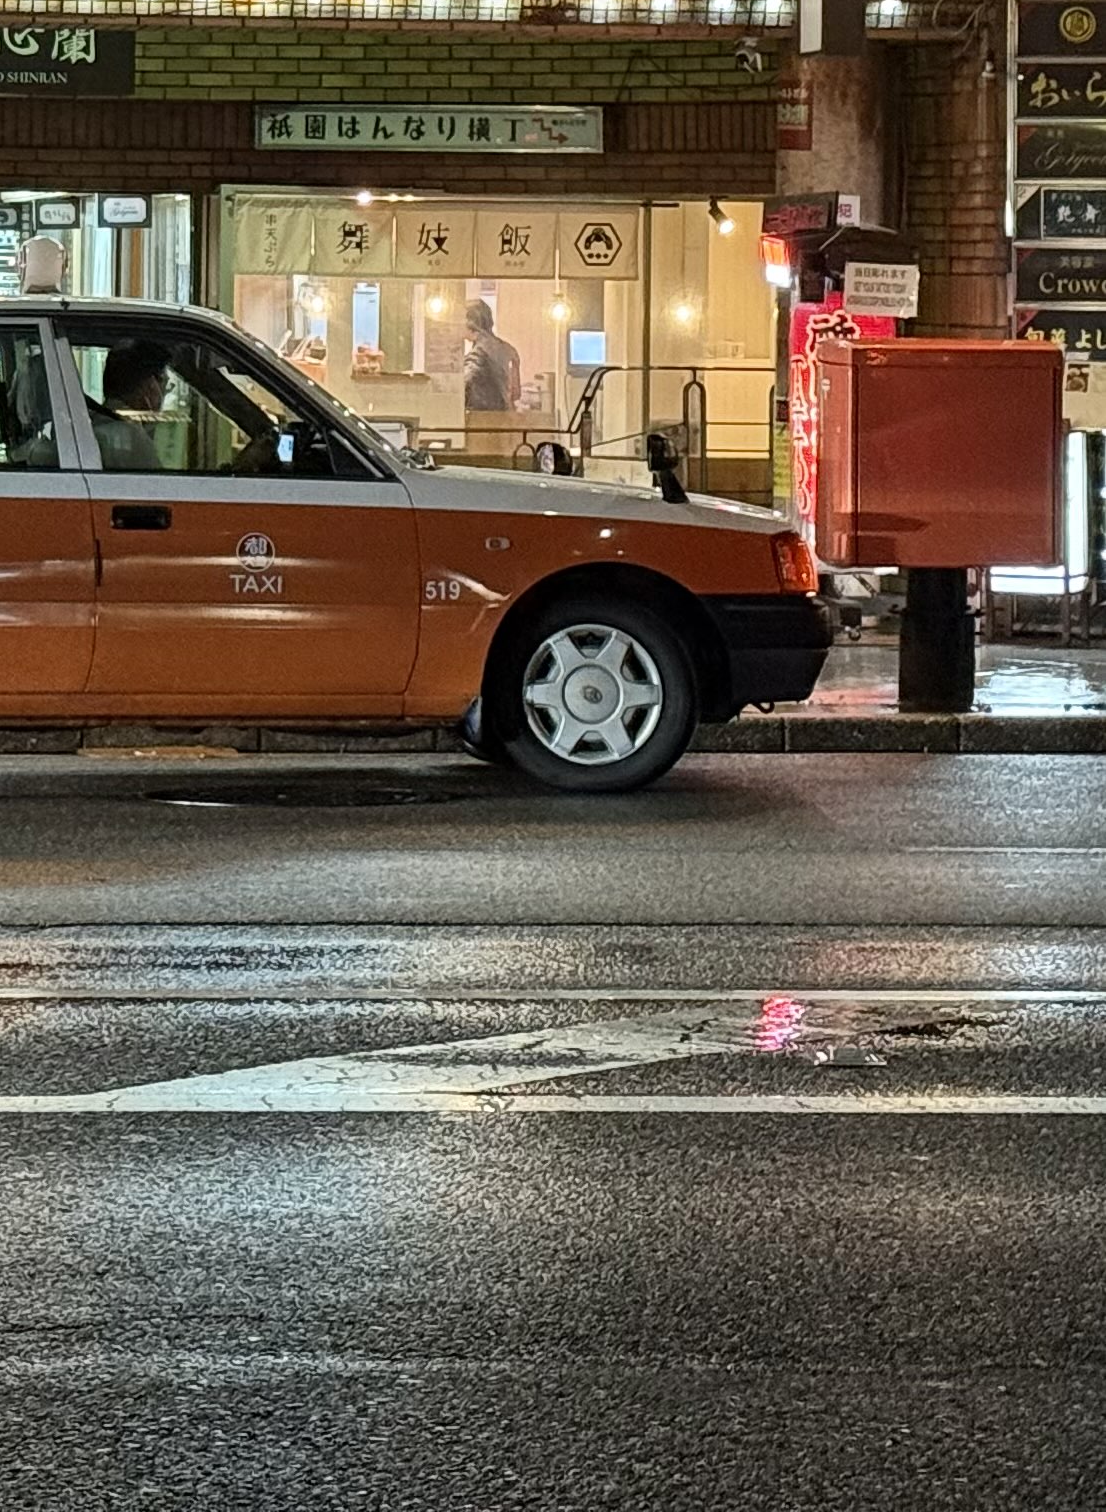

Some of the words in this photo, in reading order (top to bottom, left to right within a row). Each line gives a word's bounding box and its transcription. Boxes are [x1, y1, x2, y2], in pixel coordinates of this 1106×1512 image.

[7, 71, 67, 83] SHINRAN
[1039, 271, 1106, 294] Crow
[229, 574, 283, 594] TAXI
[425, 580, 460, 600] 519
